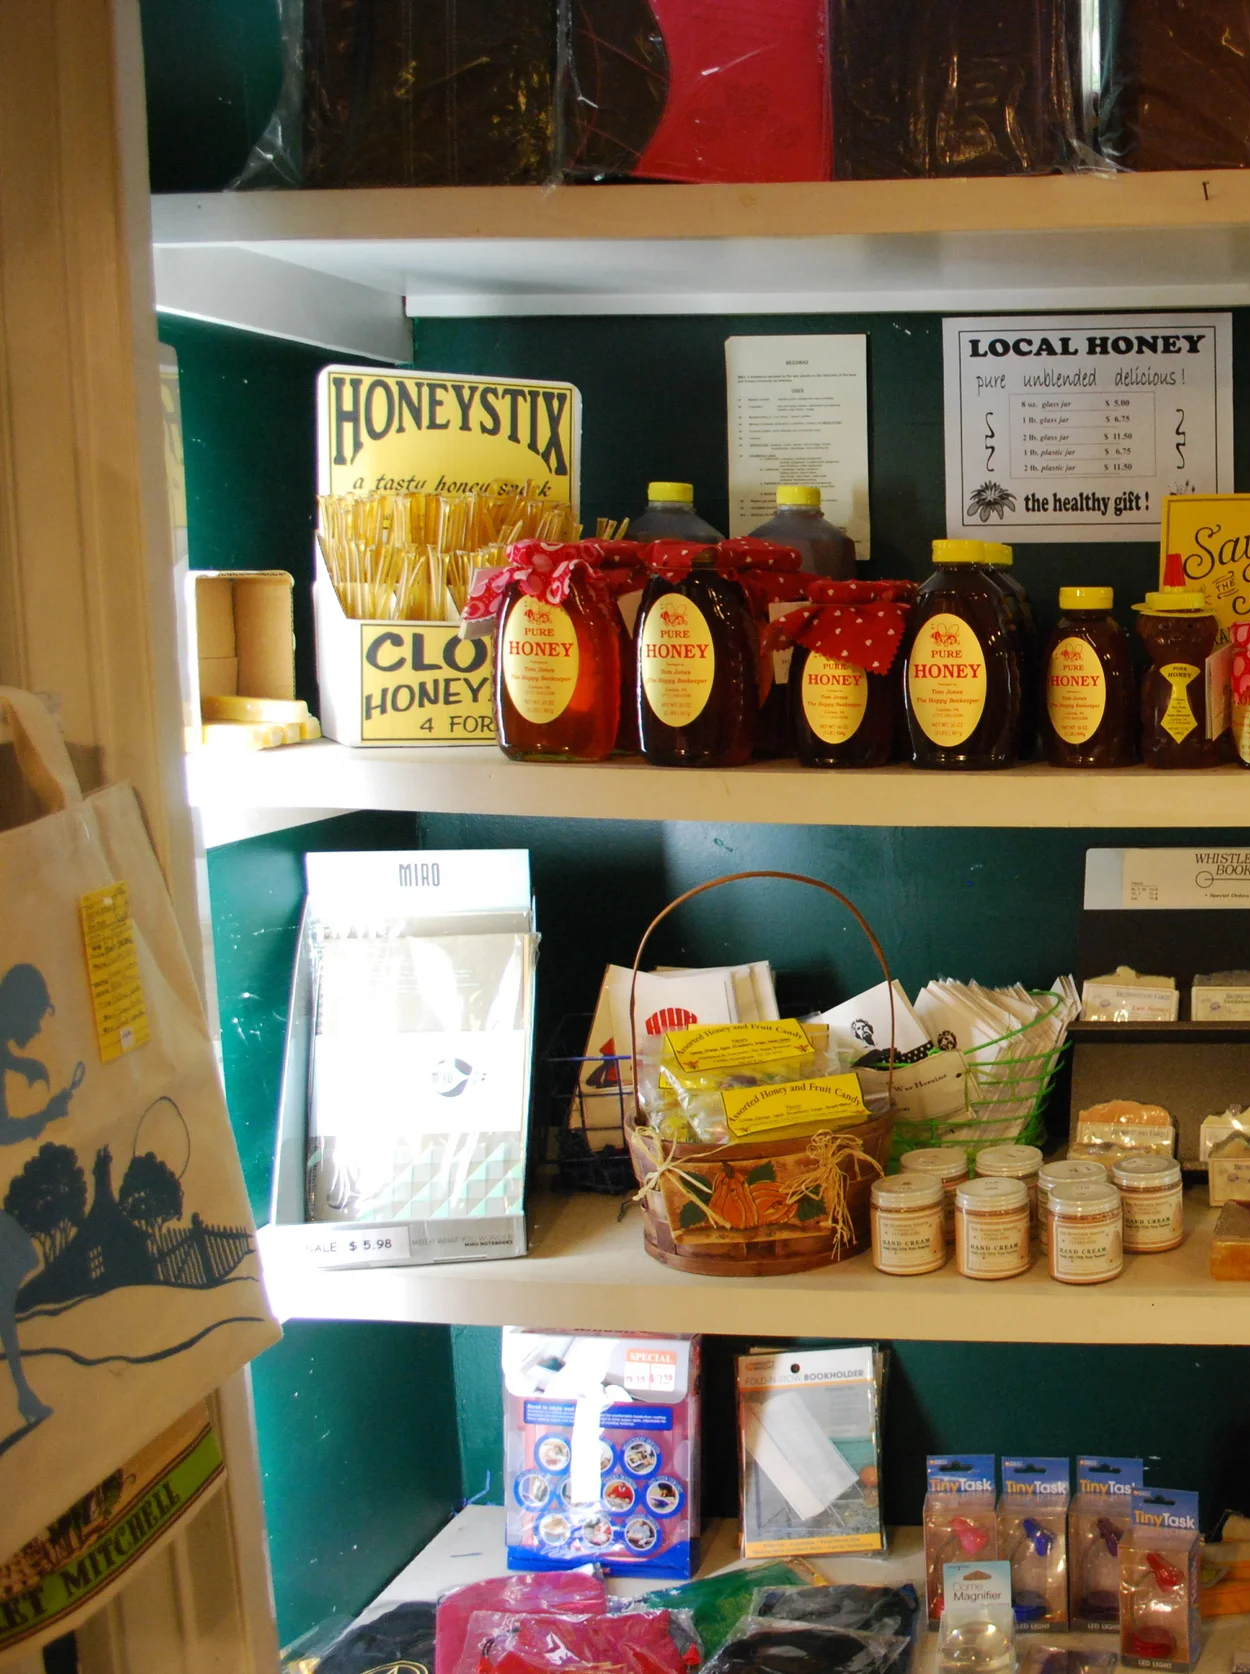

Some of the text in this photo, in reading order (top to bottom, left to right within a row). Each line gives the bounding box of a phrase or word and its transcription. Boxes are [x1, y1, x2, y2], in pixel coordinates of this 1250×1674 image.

[968, 334, 1206, 358] LOCAL HONEY
[976, 374, 1006, 396] pure
[1022, 368, 1097, 388] unblended
[1114, 366, 1177, 386] delicious
[1041, 400, 1072, 410] glass jar
[332, 375, 569, 476] HONEYSTIX
[1039, 416, 1070, 425] glass jar
[1039, 433, 1133, 443] glass jar 11.50
[1040, 448, 1076, 458] plastic jar
[1041, 463, 1133, 474] plastic jar 11.50
[352, 477, 364, 490] a
[1023, 493, 1049, 513] the
[1052, 492, 1110, 517] healthy
[1114, 491, 1142, 515] gift
[1216, 578, 1237, 593] THE
[524, 627, 555, 637] PURE
[660, 630, 690, 639] PURE
[508, 640, 574, 657] HONEY
[646, 643, 710, 659] HONEY
[931, 649, 962, 659] PURE
[823, 663, 846, 671] PURE
[913, 663, 981, 679] HONEY
[1063, 664, 1084, 672] PURE
[808, 673, 862, 687] HONEY
[1050, 675, 1100, 687] HONEY
[1167, 671, 1193, 679] HONEY
[420, 716, 496, 735] 4 FOR
[398, 862, 441, 887] MIRO
[676, 1033, 705, 1056] Assorted
[704, 1026, 731, 1040] Honey
[750, 1023, 774, 1032] Fruit
[775, 1025, 804, 1041] Candy
[913, 1073, 948, 1090] Heroine
[728, 1094, 760, 1124] Assorted
[759, 1085, 789, 1102] Honey
[790, 1083, 808, 1093] and
[808, 1082, 833, 1094] Fruit
[834, 1087, 862, 1107] Candy
[1148, 1215, 1171, 1224] CREAM
[305, 1239, 393, 1254] SALE $ 5.98
[882, 1236, 931, 1246] HAND CREAM
[992, 1242, 1019, 1251] CREAM
[1059, 1246, 1107, 1255] HAND CREAM
[629, 1352, 673, 1363] SPECIAL
[804, 1369, 865, 1382] BOOKHOLDER
[929, 1477, 993, 1494] TinyTask
[1005, 1479, 1069, 1496] TinyTask
[1134, 1509, 1196, 1529] TinyTask
[60, 1479, 181, 1598] MITCHELL
[952, 1581, 984, 1592] Dome
[953, 1590, 1003, 1603] Magnifier
[1138, 1659, 1174, 1670] LED LIGHT
